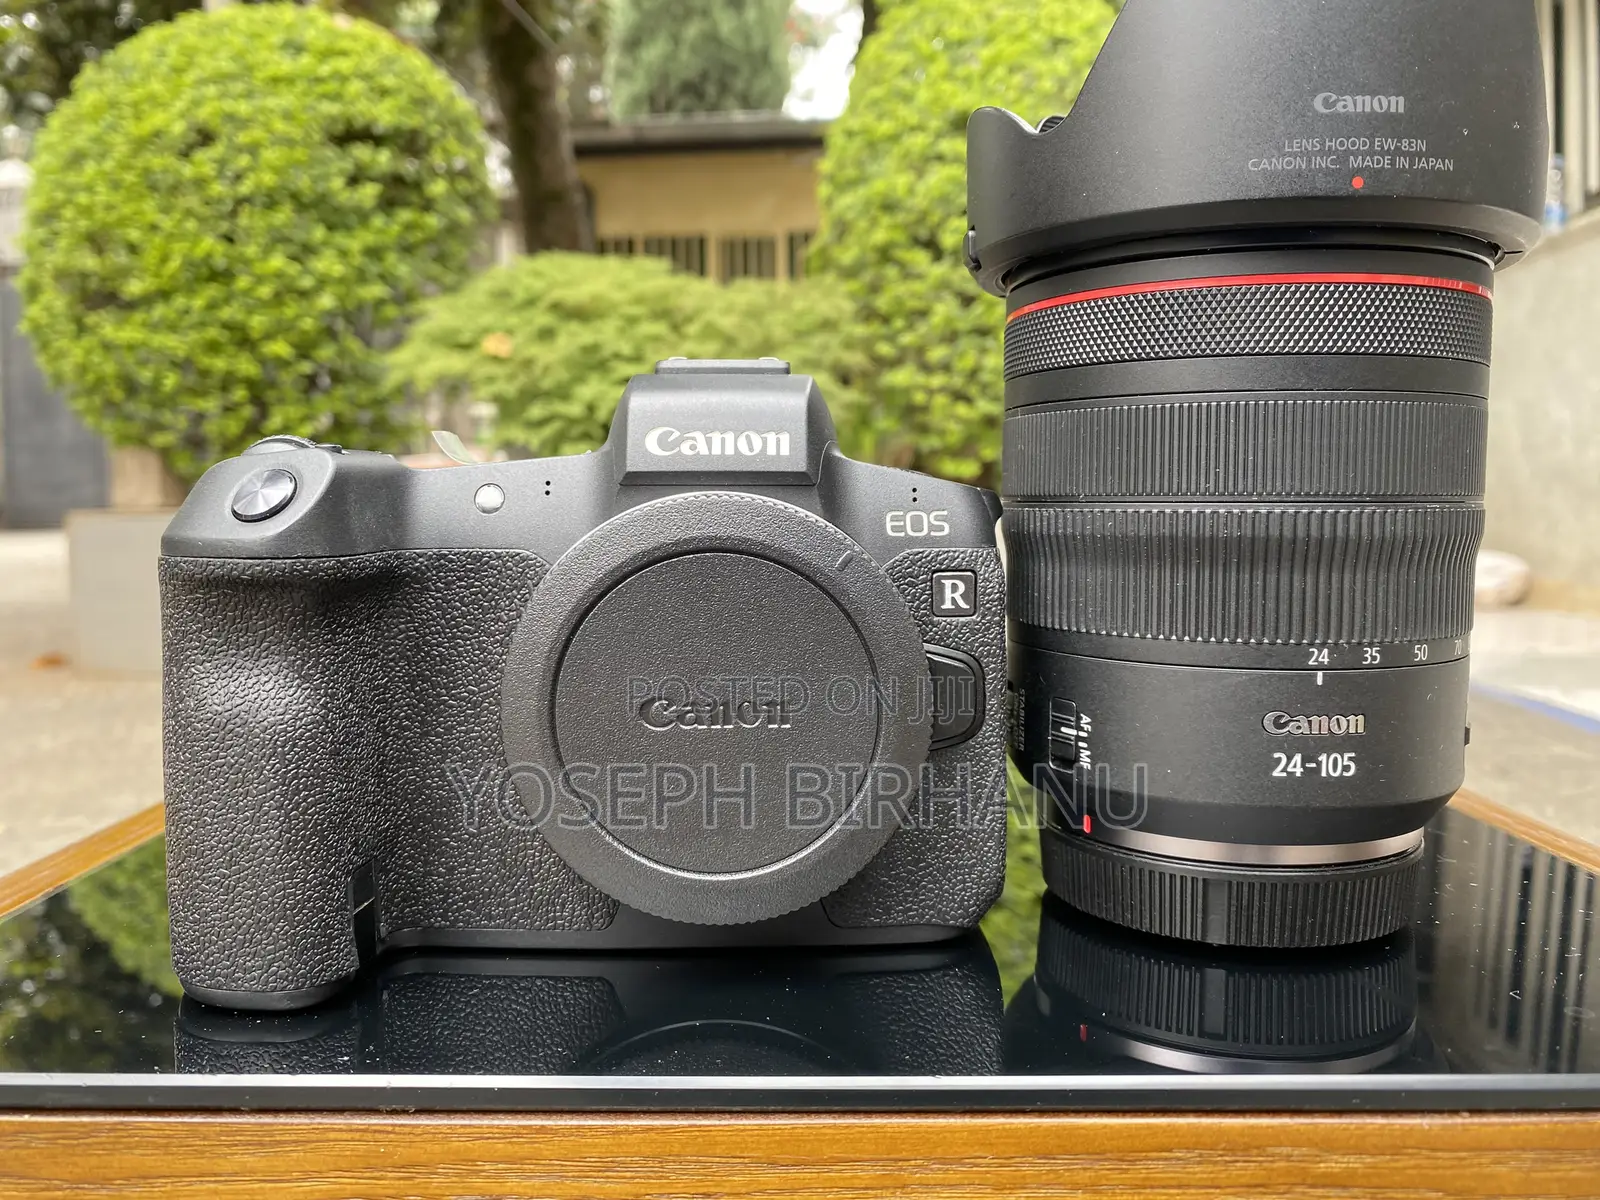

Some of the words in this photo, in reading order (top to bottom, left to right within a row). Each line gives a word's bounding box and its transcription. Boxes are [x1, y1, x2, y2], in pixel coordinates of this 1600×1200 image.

[1313, 92, 1405, 113] Canon
[1284, 138, 1321, 152] LENS
[1325, 137, 1370, 151] HOOD
[1374, 137, 1427, 152] EW-83N
[1248, 156, 1307, 171] CANON
[1311, 155, 1340, 168] INC.
[1349, 155, 1392, 169] MADE
[1396, 156, 1410, 169] IN
[1413, 156, 1454, 172] JAPAN
[644, 427, 790, 456] Canon
[885, 510, 950, 537] EOS
[940, 579, 970, 610] R
[1308, 648, 1330, 665] 24
[1362, 647, 1381, 665] 35
[1414, 644, 1428, 661] 50
[639, 698, 793, 731] Canon
[1079, 713, 1092, 732] AF
[1262, 711, 1366, 736] Canon
[1079, 749, 1092, 771] MF
[1271, 752, 1357, 777] 24-105
